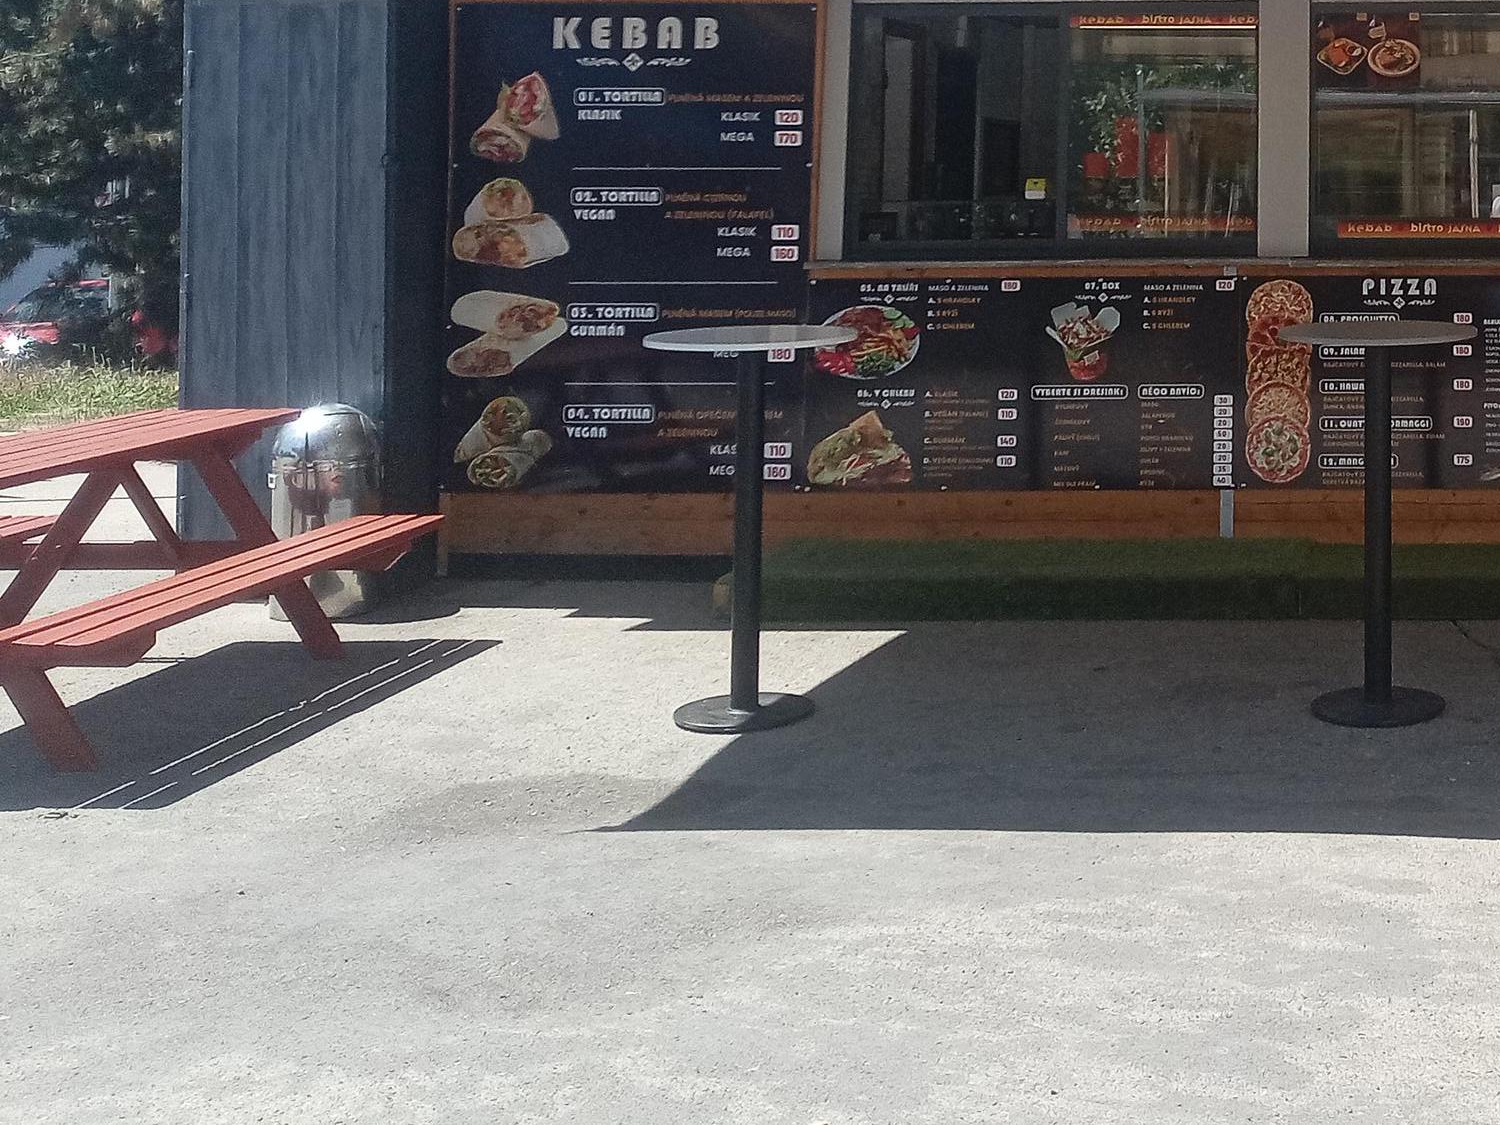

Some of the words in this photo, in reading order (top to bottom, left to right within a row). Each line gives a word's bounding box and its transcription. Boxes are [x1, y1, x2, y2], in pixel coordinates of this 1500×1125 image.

[552, 17, 721, 50] KEBAB
[577, 91, 600, 102] 01.
[604, 91, 662, 102] TORTILLA
[720, 111, 761, 122] KLASIK
[778, 112, 800, 123] 120
[720, 131, 755, 142] MEGA
[574, 191, 597, 202] 02.
[600, 191, 659, 202] TORTILLA
[573, 209, 616, 221] VEGAN
[717, 226, 757, 237] KLASIK
[776, 226, 794, 238] 110
[716, 246, 751, 257] MEGA
[1085, 281, 1100, 290] 07.
[1102, 281, 1121, 290] BOX
[1218, 281, 1232, 289] 120
[1362, 278, 1438, 296] PIZZA
[1143, 296, 1151, 304] A.
[596, 306, 655, 318] TORTILLA
[1455, 314, 1470, 323] 180
[570, 322, 626, 336] GURMÁN
[1323, 346, 1338, 355] 09.
[1455, 346, 1470, 355] 180
[1323, 382, 1338, 391] 10.
[1455, 381, 1470, 389] 180
[1000, 391, 1015, 399] 120
[1035, 388, 1071, 396] VYBERTE
[1073, 388, 1080, 396] SI
[591, 407, 651, 420] TORTILLA
[1001, 410, 1014, 419] 110
[1323, 420, 1338, 428] 11.
[1456, 418, 1470, 426] 190
[566, 426, 608, 438] VEGAN
[999, 437, 1014, 446] 140
[769, 445, 786, 457] 110
[1000, 457, 1014, 465] 110
[1456, 456, 1470, 465] 175
[708, 465, 736, 476] MEG
